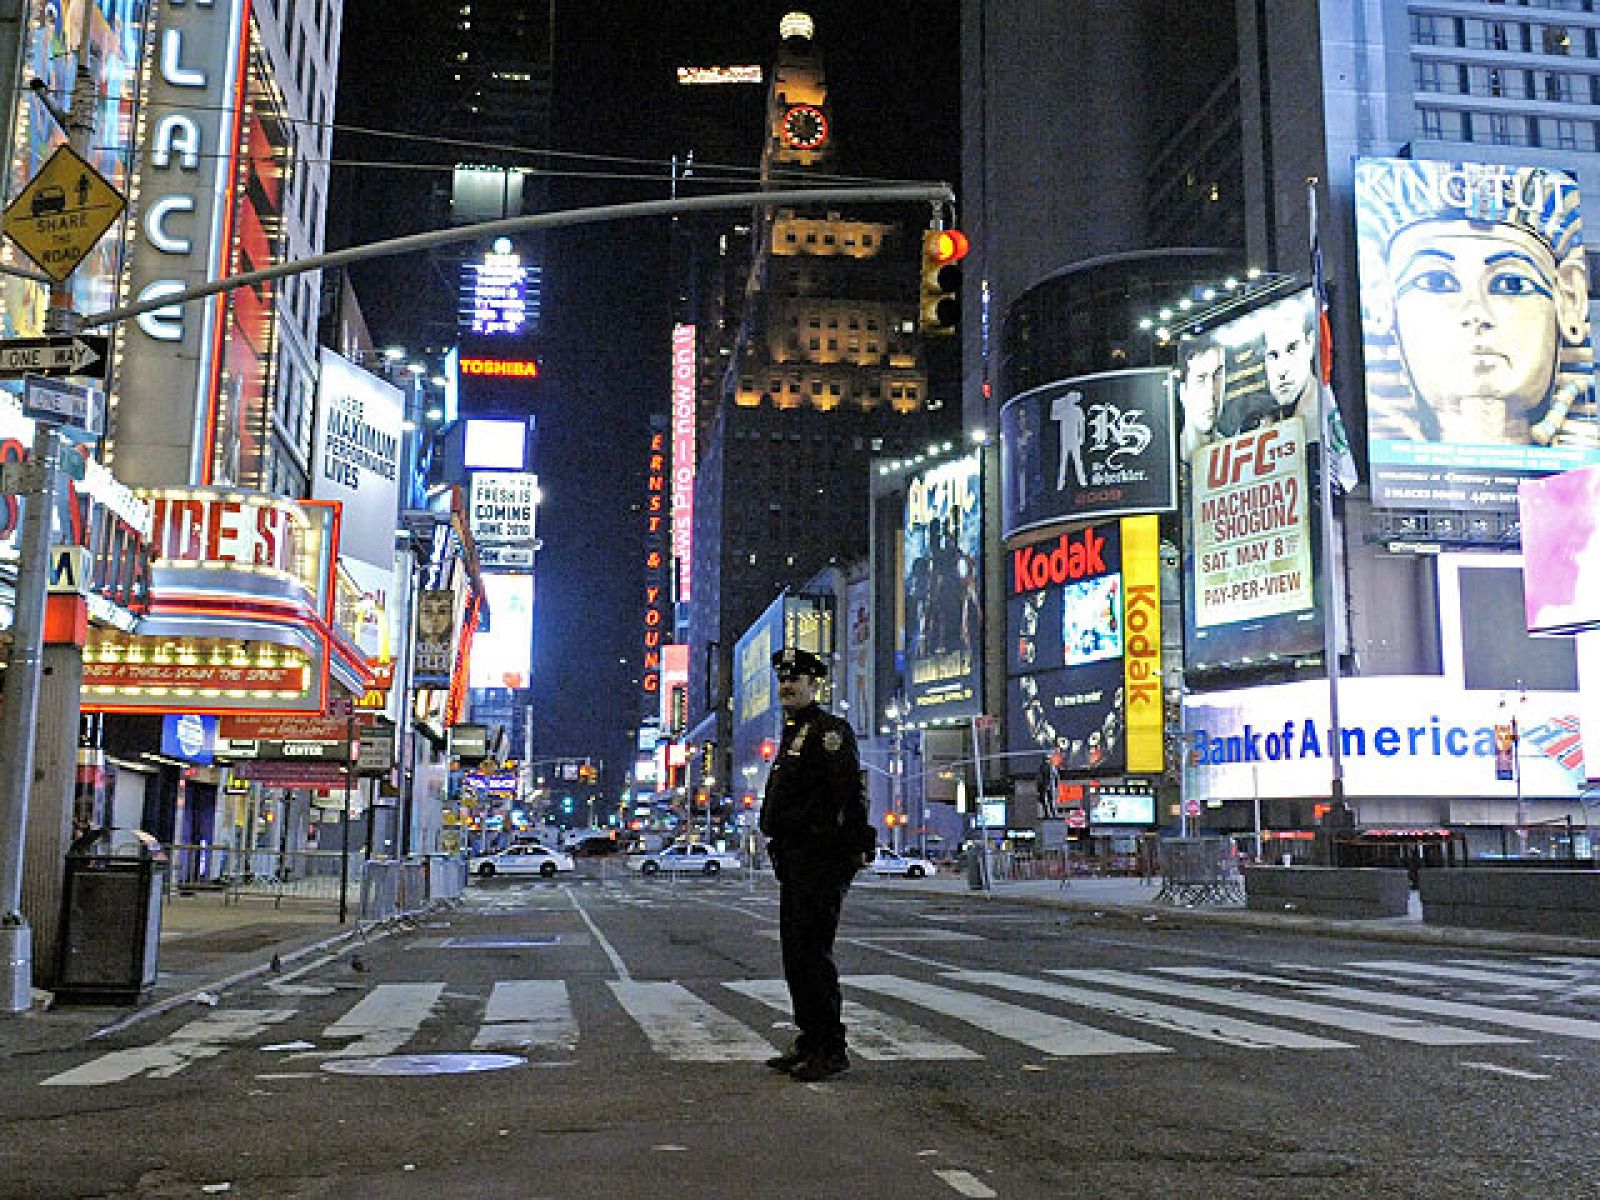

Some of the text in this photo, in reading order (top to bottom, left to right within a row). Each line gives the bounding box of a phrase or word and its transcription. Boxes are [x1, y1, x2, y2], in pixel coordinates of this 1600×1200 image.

[137, 0, 211, 342] LACE
[1362, 164, 1471, 209] KING
[36, 214, 87, 233] SHARE
[43, 244, 81, 263] ROAD
[10, 343, 86, 367] ONE WAY
[459, 358, 537, 377] TOSHIBA
[327, 406, 398, 463] MAXIMUM
[324, 455, 359, 491] LIVES
[649, 431, 664, 532] ERNST
[1207, 430, 1279, 488] UFC
[475, 504, 531, 521] COMING
[1202, 477, 1299, 526] MACHIDA 2
[1214, 503, 1286, 543] SHOGUN
[1014, 526, 1106, 594] Kodak
[1237, 541, 1268, 565] MAY
[1203, 571, 1301, 606] PAY-PER-VIEW
[643, 586, 661, 691] YOUNG
[1127, 584, 1158, 705] Kodak
[1193, 714, 1498, 766] Bank of America
